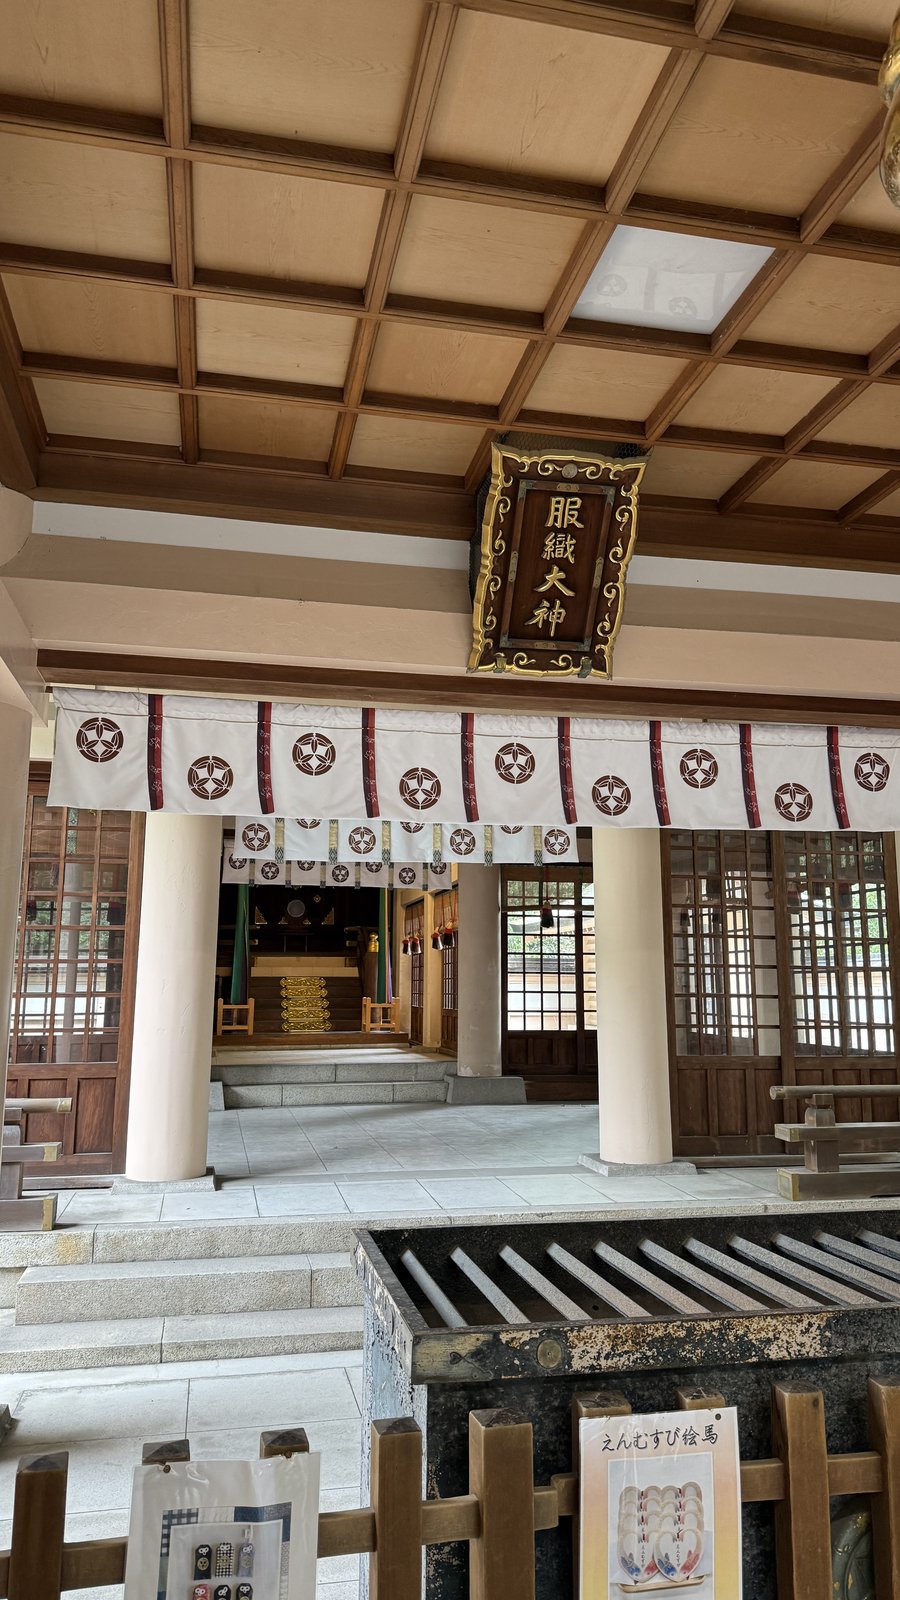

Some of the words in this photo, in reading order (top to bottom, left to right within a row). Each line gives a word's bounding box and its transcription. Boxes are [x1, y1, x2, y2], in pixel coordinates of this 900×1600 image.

[524, 496, 584, 637] 服織大神
[601, 1423, 719, 1452] えんむすび絵馬
